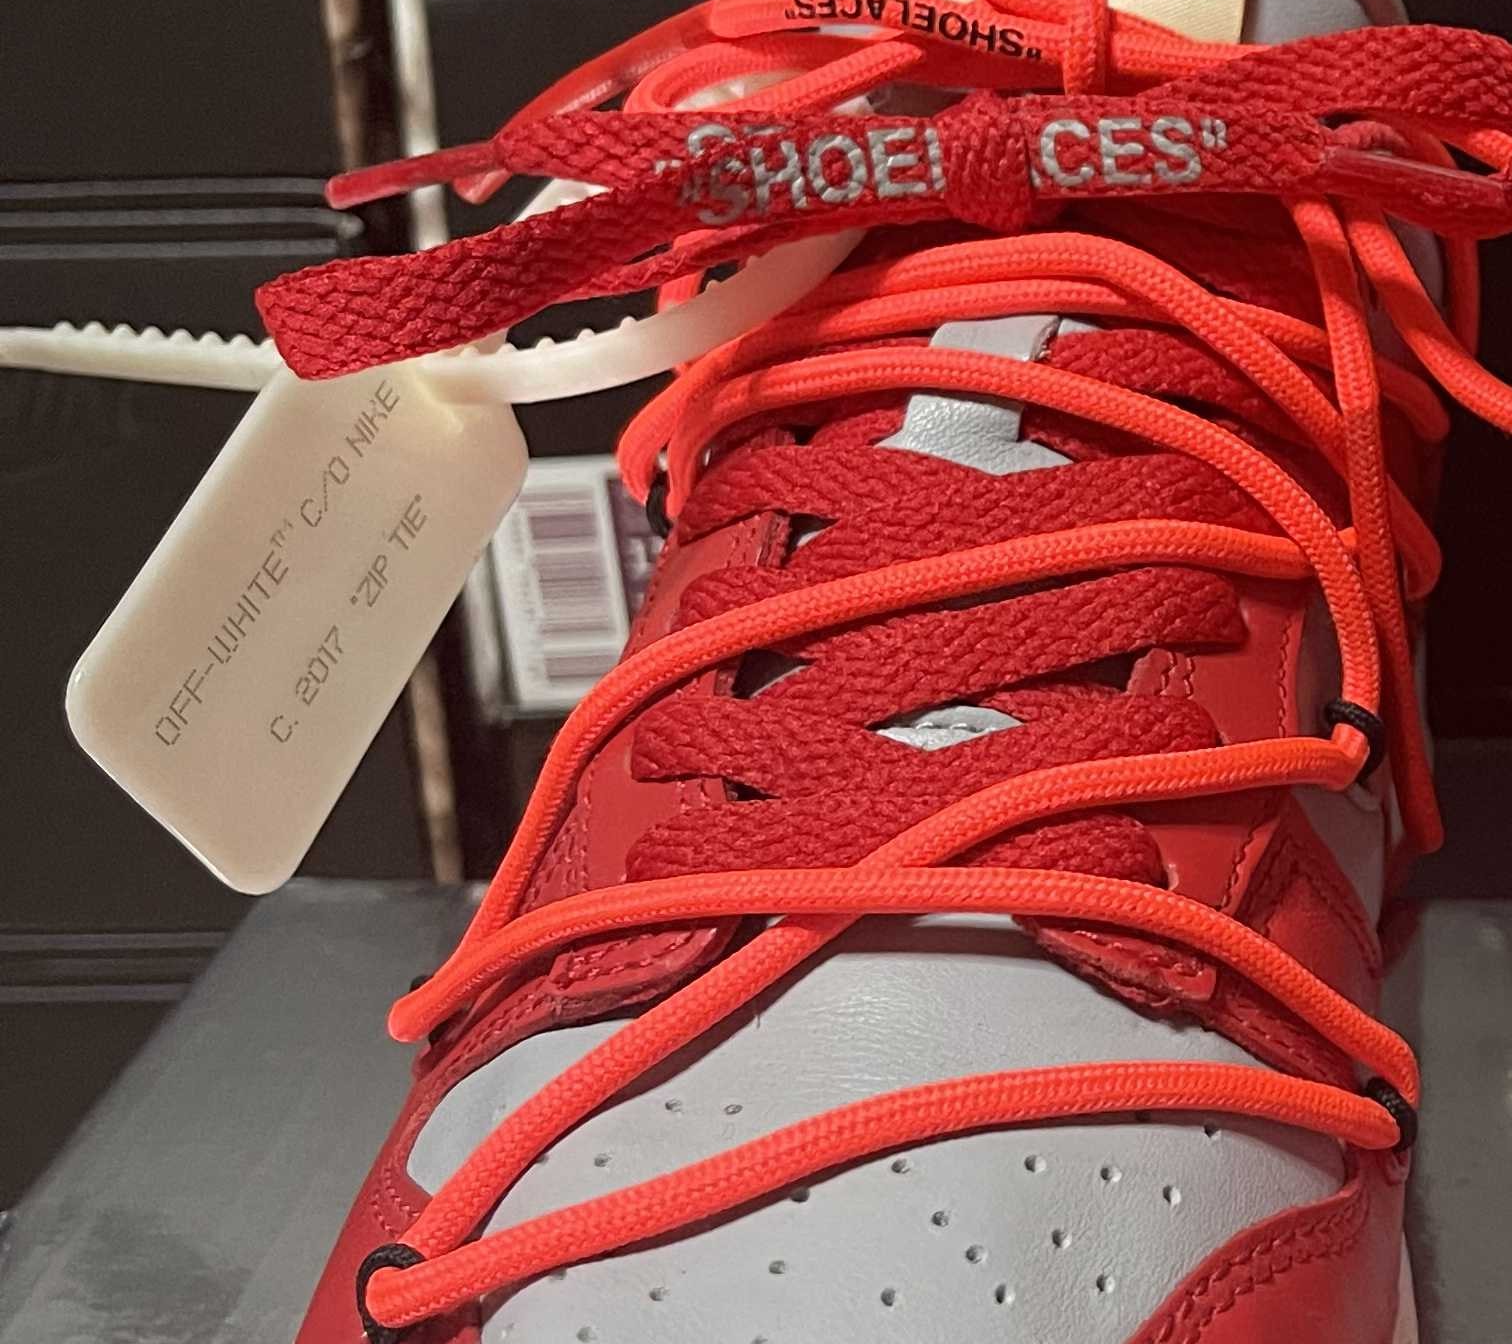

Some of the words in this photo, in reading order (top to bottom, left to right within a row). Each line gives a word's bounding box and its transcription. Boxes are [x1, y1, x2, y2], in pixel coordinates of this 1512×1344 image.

[300, 457, 350, 527] C/O
[345, 379, 401, 457] NIKE
[269, 715, 299, 744] C.
[295, 626, 345, 707] 2017
